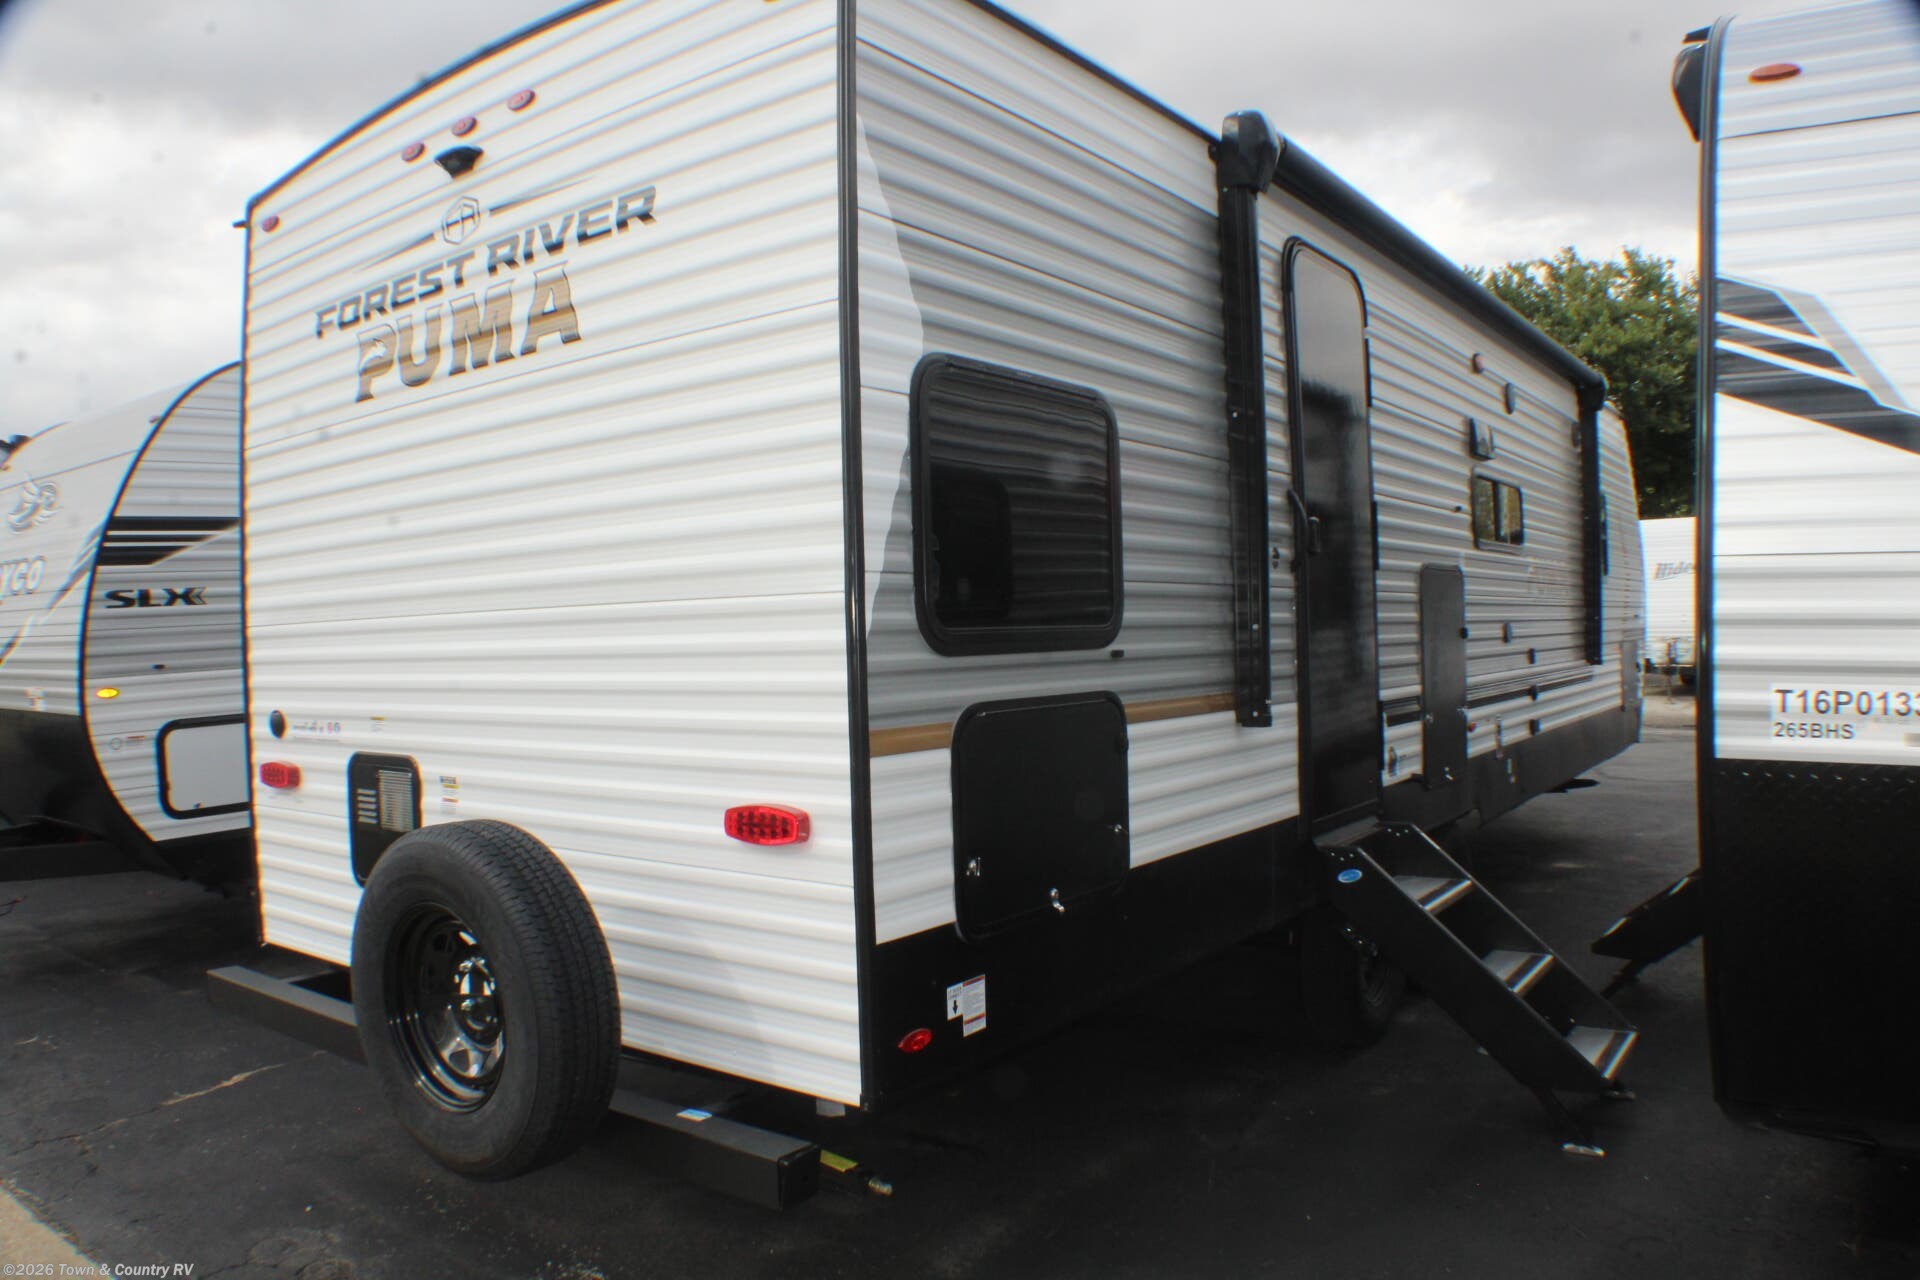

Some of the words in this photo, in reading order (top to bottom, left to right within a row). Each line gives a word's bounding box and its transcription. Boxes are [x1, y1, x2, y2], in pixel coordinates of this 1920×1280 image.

[315, 250, 477, 340] FOREST
[486, 185, 657, 276] RIVER
[354, 260, 583, 403] PUMA
[103, 586, 207, 609] SLX
[1773, 721, 1856, 740] 265BHS
